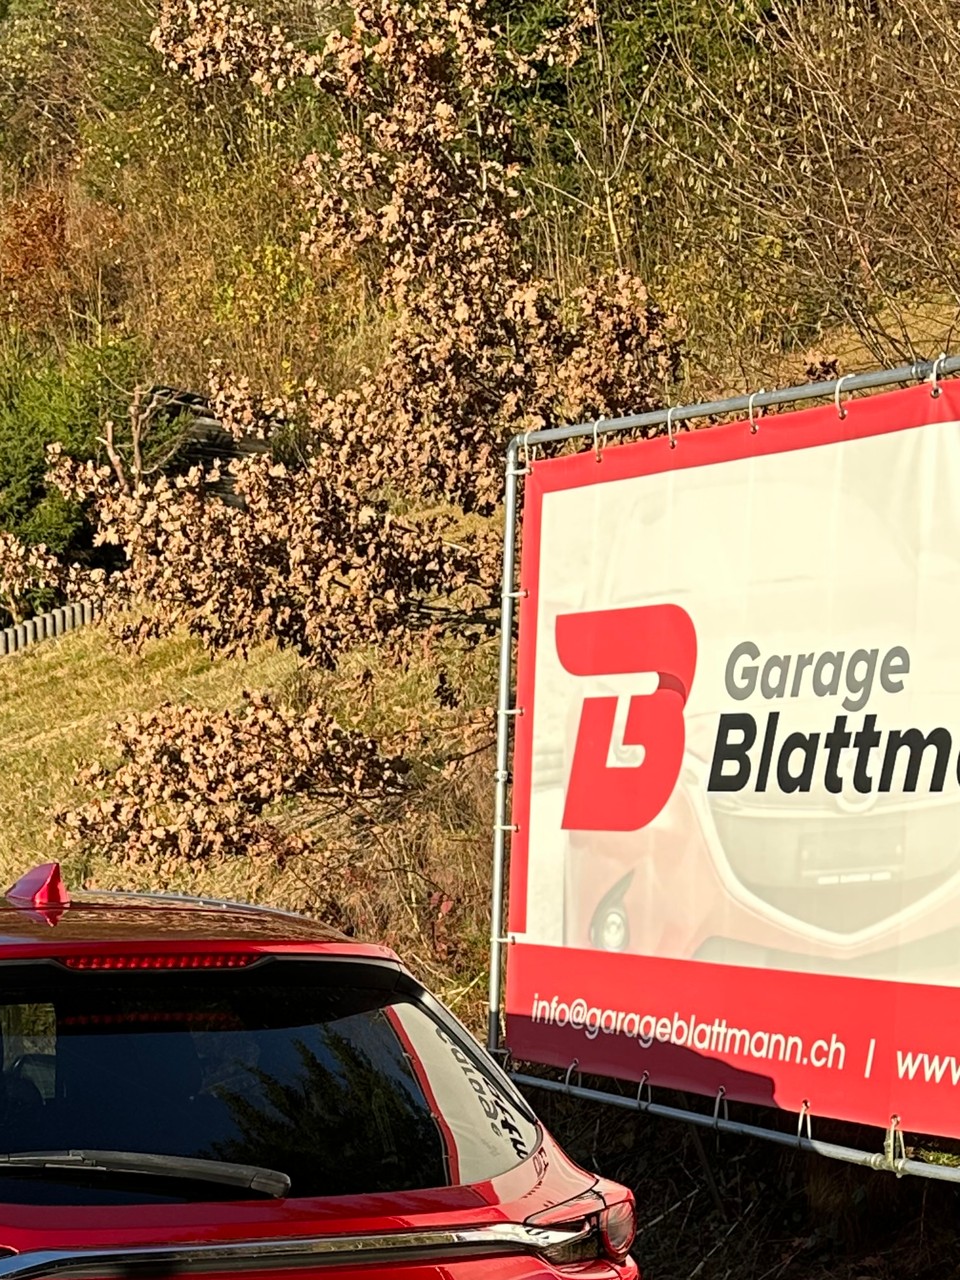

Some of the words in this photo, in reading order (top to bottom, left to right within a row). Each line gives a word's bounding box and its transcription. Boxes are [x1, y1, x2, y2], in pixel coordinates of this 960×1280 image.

[724, 641, 910, 712] Garage
[707, 711, 960, 794] Blattm
[531, 993, 845, 1070] info@garageblattmann.ch
